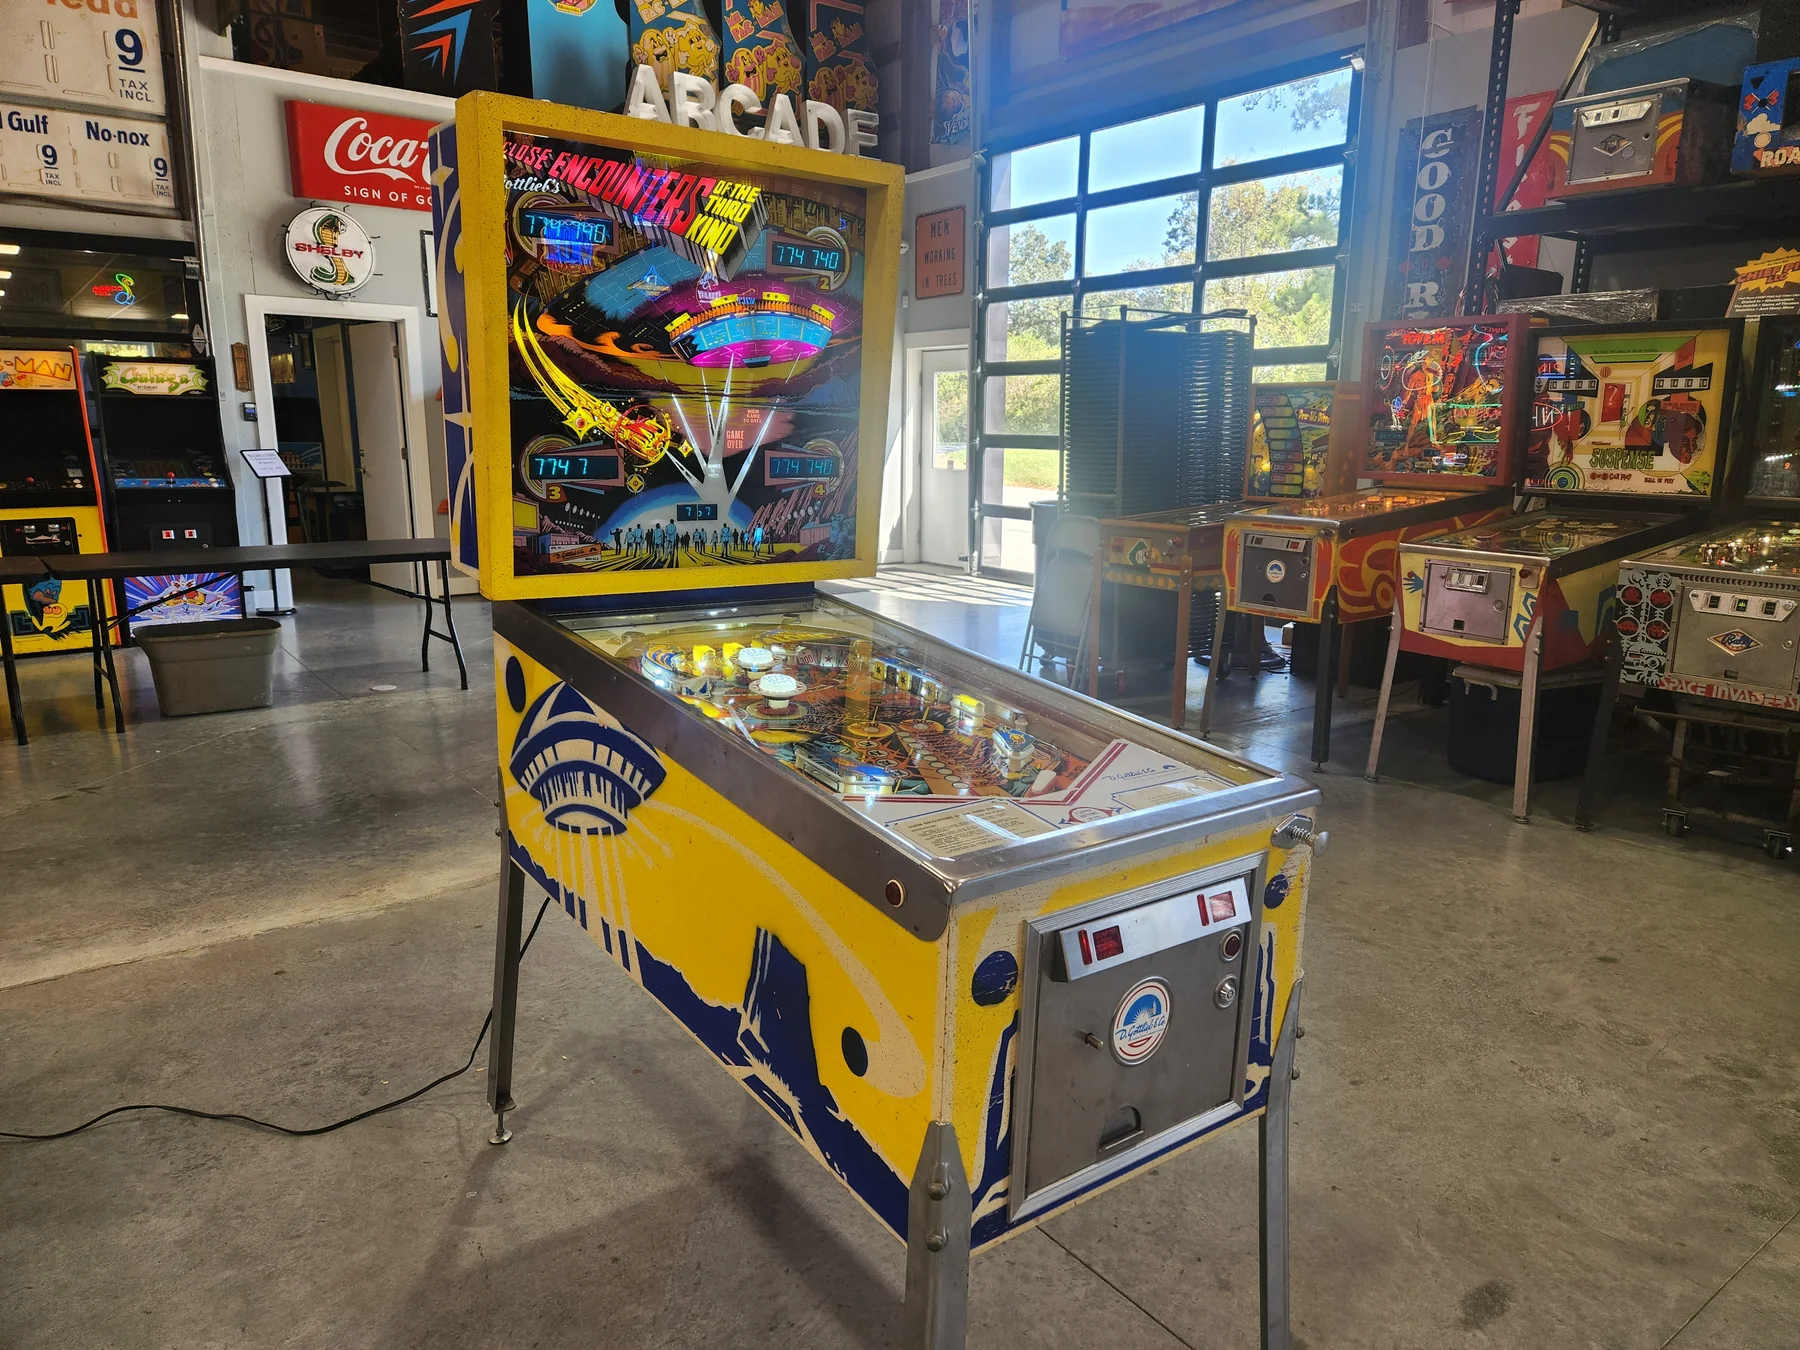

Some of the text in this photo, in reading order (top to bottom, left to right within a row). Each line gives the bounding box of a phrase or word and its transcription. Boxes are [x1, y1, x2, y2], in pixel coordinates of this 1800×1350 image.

[115, 28, 143, 66] 9
[119, 78, 149, 91] TAX
[120, 90, 155, 103] INCL.
[623, 64, 882, 161] ARCADE
[8, 110, 49, 135] Gulf
[42, 144, 58, 166] 9
[45, 172, 60, 180] TAX
[153, 157, 168, 178] 9
[503, 173, 560, 194] ottlieb's
[503, 141, 717, 236] CLOSE ENCOUNTERS
[713, 180, 761, 203] OF THE
[344, 185, 381, 200] SIGN
[388, 191, 409, 203] OF
[704, 194, 752, 223] THIRD
[685, 213, 739, 255] KIND
[930, 219, 949, 238] MEN
[294, 242, 365, 259] SHELBY
[776, 245, 840, 270] 774 740
[924, 247, 956, 265] WORKING
[921, 272, 957, 289] IN TREES
[1736, 266, 1782, 283] CHIEF
[819, 278, 831, 291] 2
[1402, 331, 1446, 345] TOTEM
[0, 356, 73, 382] -MAN
[726, 430, 744, 440] GAME
[727, 440, 743, 449] OVER
[534, 458, 588, 476] 774 7
[772, 458, 834, 475] 774 740
[1589, 448, 1656, 470] SUSPENSE
[548, 485, 561, 500] 3
[814, 484, 826, 496] 4
[1658, 675, 1800, 712] SPACE INVADERS
[1128, 1018, 1154, 1042] Gottlieb
